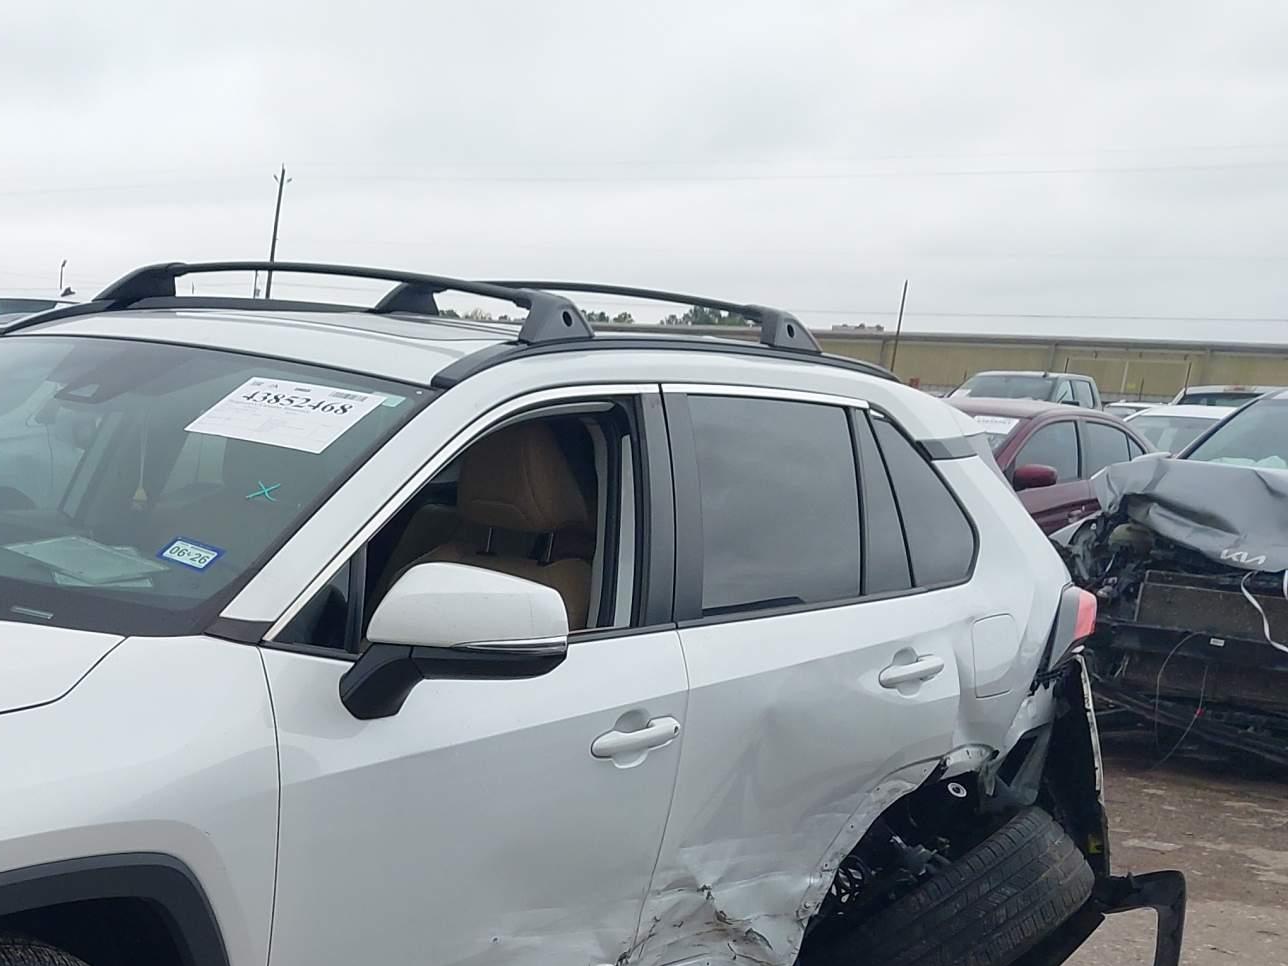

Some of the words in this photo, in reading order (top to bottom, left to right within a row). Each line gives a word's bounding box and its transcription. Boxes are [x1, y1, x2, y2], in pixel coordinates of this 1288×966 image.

[242, 390, 353, 416] 43852468
[169, 546, 188, 557] 06
[190, 553, 210, 564] 26
